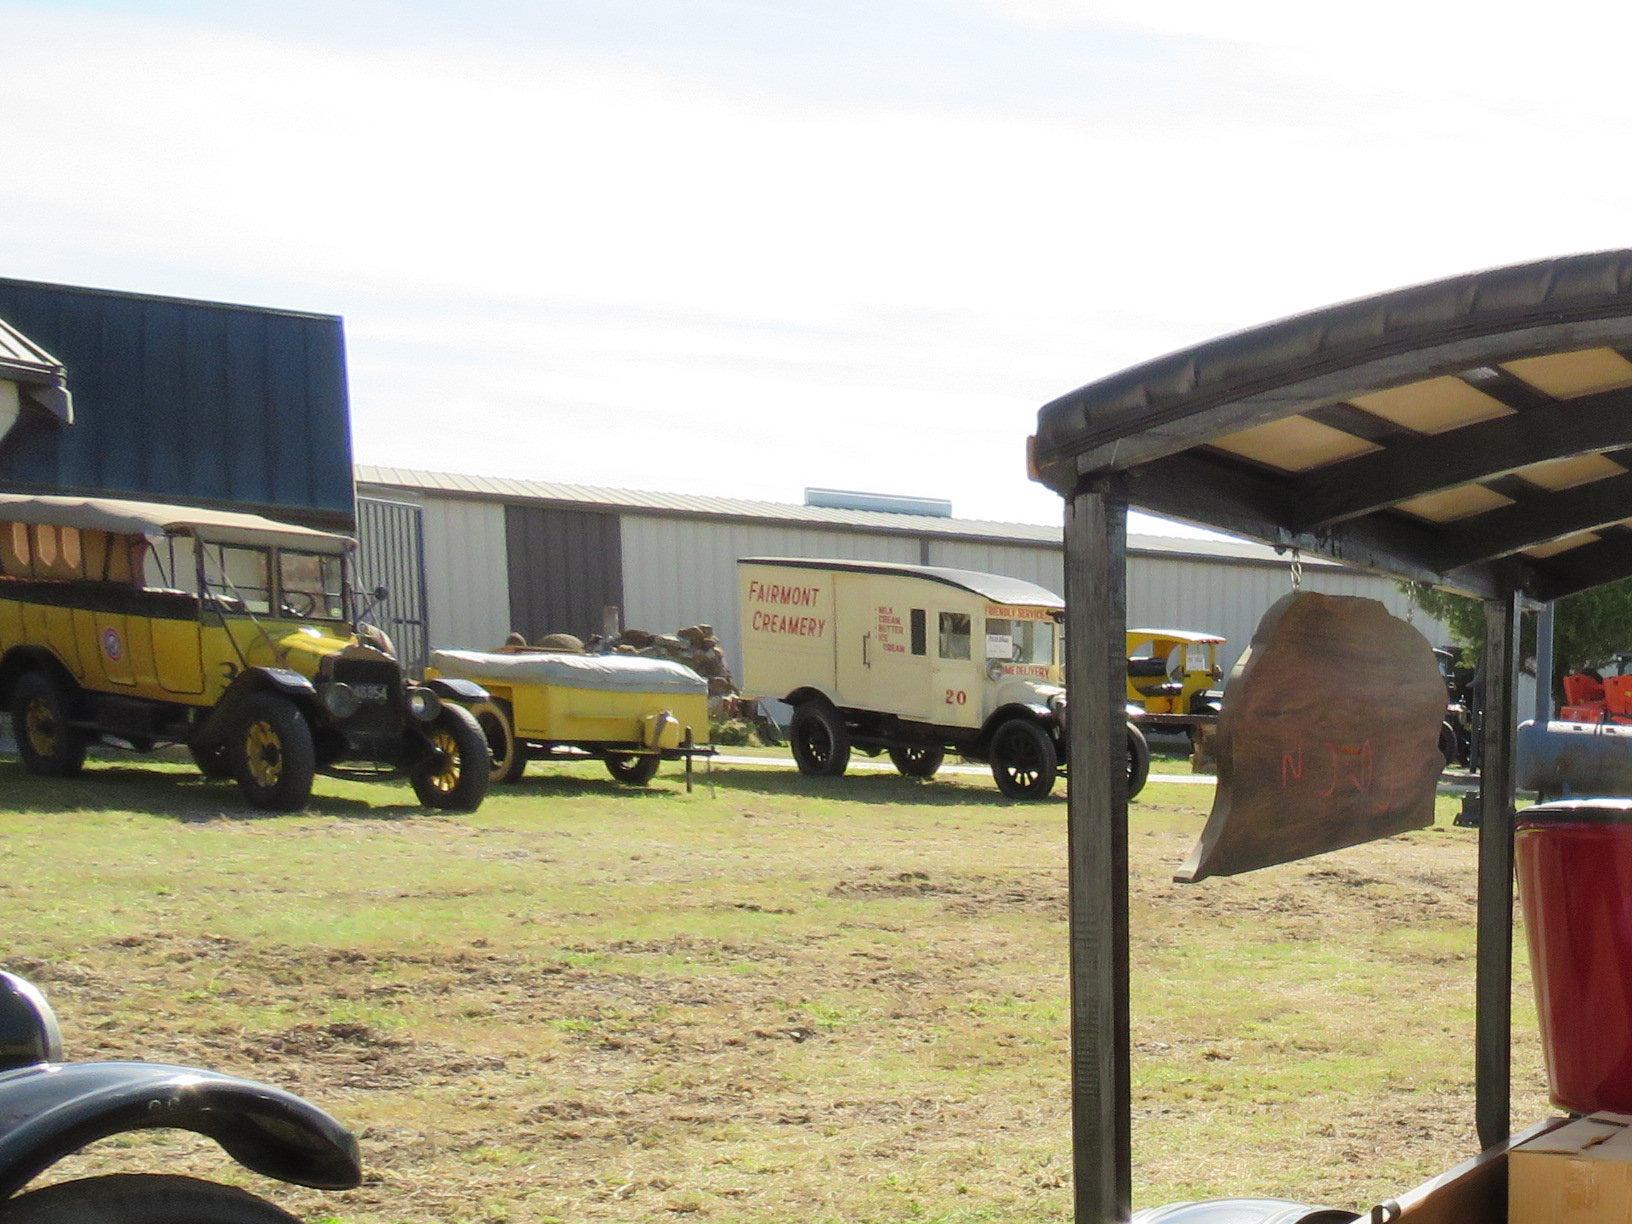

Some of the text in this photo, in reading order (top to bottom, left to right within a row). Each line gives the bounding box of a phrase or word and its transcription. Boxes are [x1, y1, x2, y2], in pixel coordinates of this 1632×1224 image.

[748, 581, 820, 607] FAIRMONT
[752, 611, 826, 638] CREAMERY
[945, 688, 967, 705] 20
